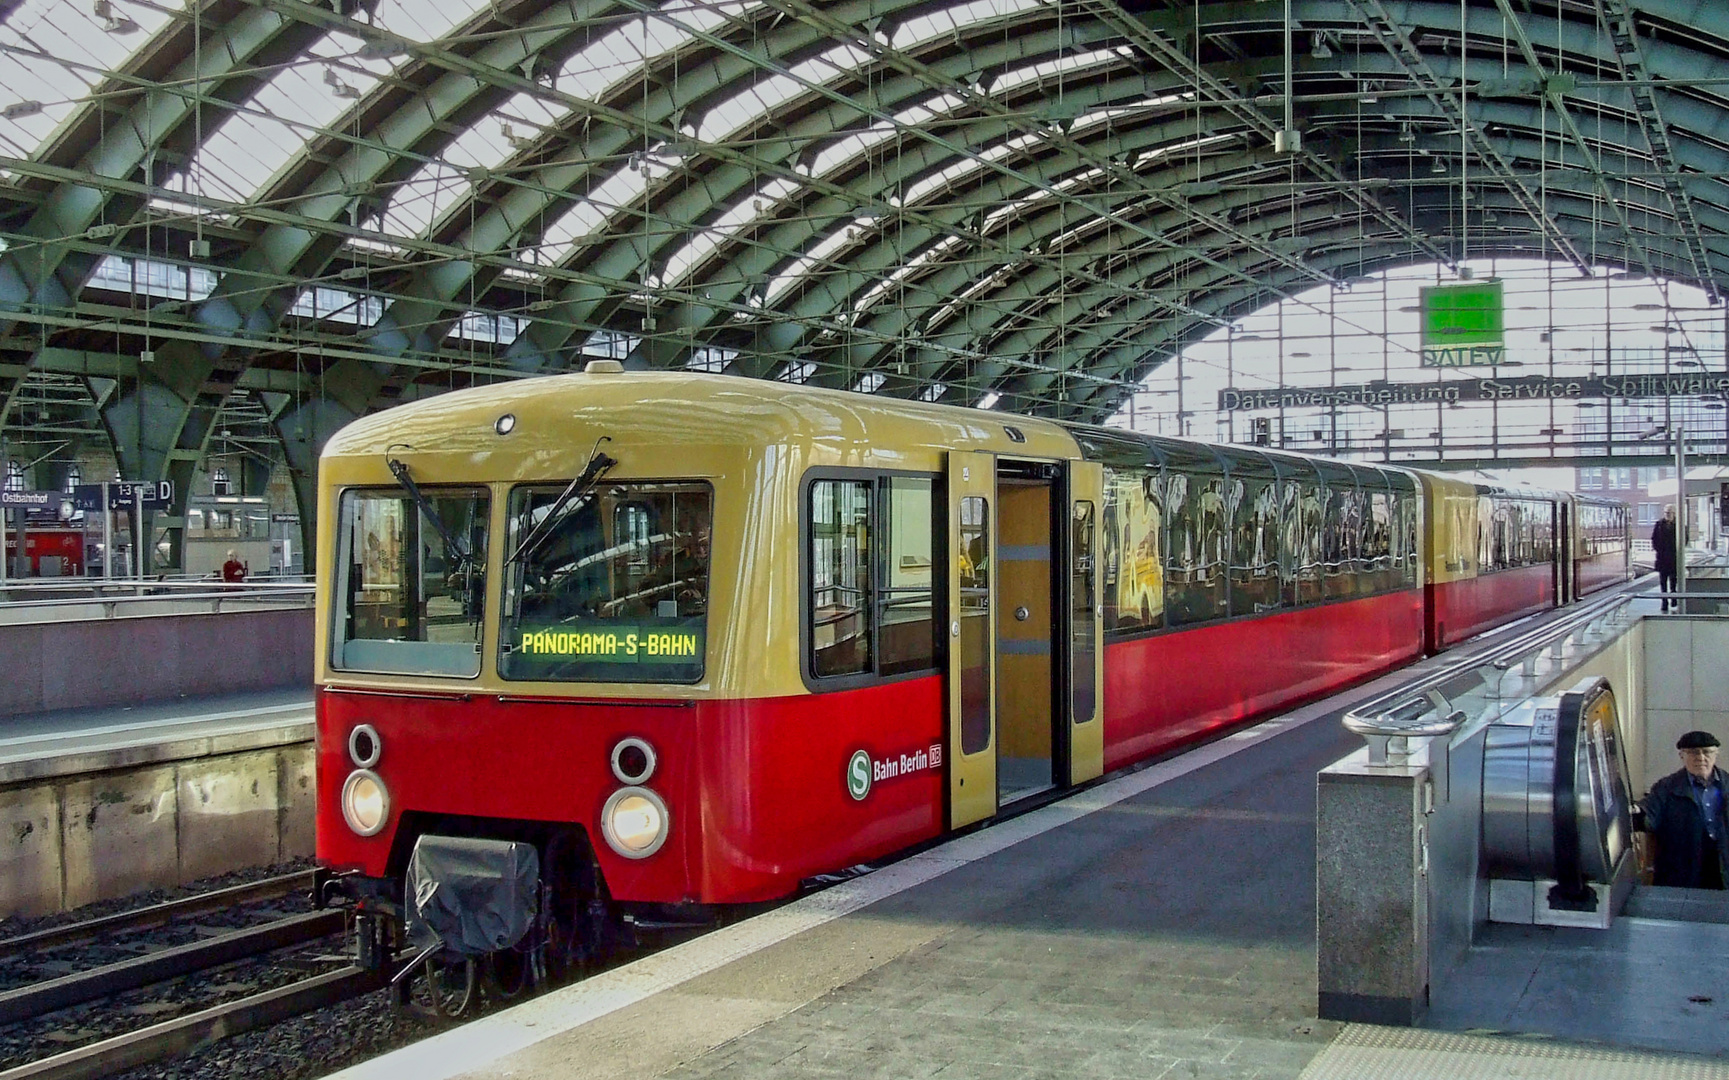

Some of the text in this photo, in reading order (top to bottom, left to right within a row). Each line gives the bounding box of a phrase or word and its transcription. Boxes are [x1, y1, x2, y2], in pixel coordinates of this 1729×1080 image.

[1423, 347, 1503, 367] DATEV
[1479, 379, 1582, 400] Service
[1602, 373, 1729, 400] Software
[2, 493, 48, 504] Ostbahnhof
[160, 481, 171, 500] D
[522, 633, 696, 656] PANORAMA-S-BAHN
[851, 754, 869, 797] S
[874, 757, 898, 782] Bahn
[900, 749, 928, 775] Berlin
